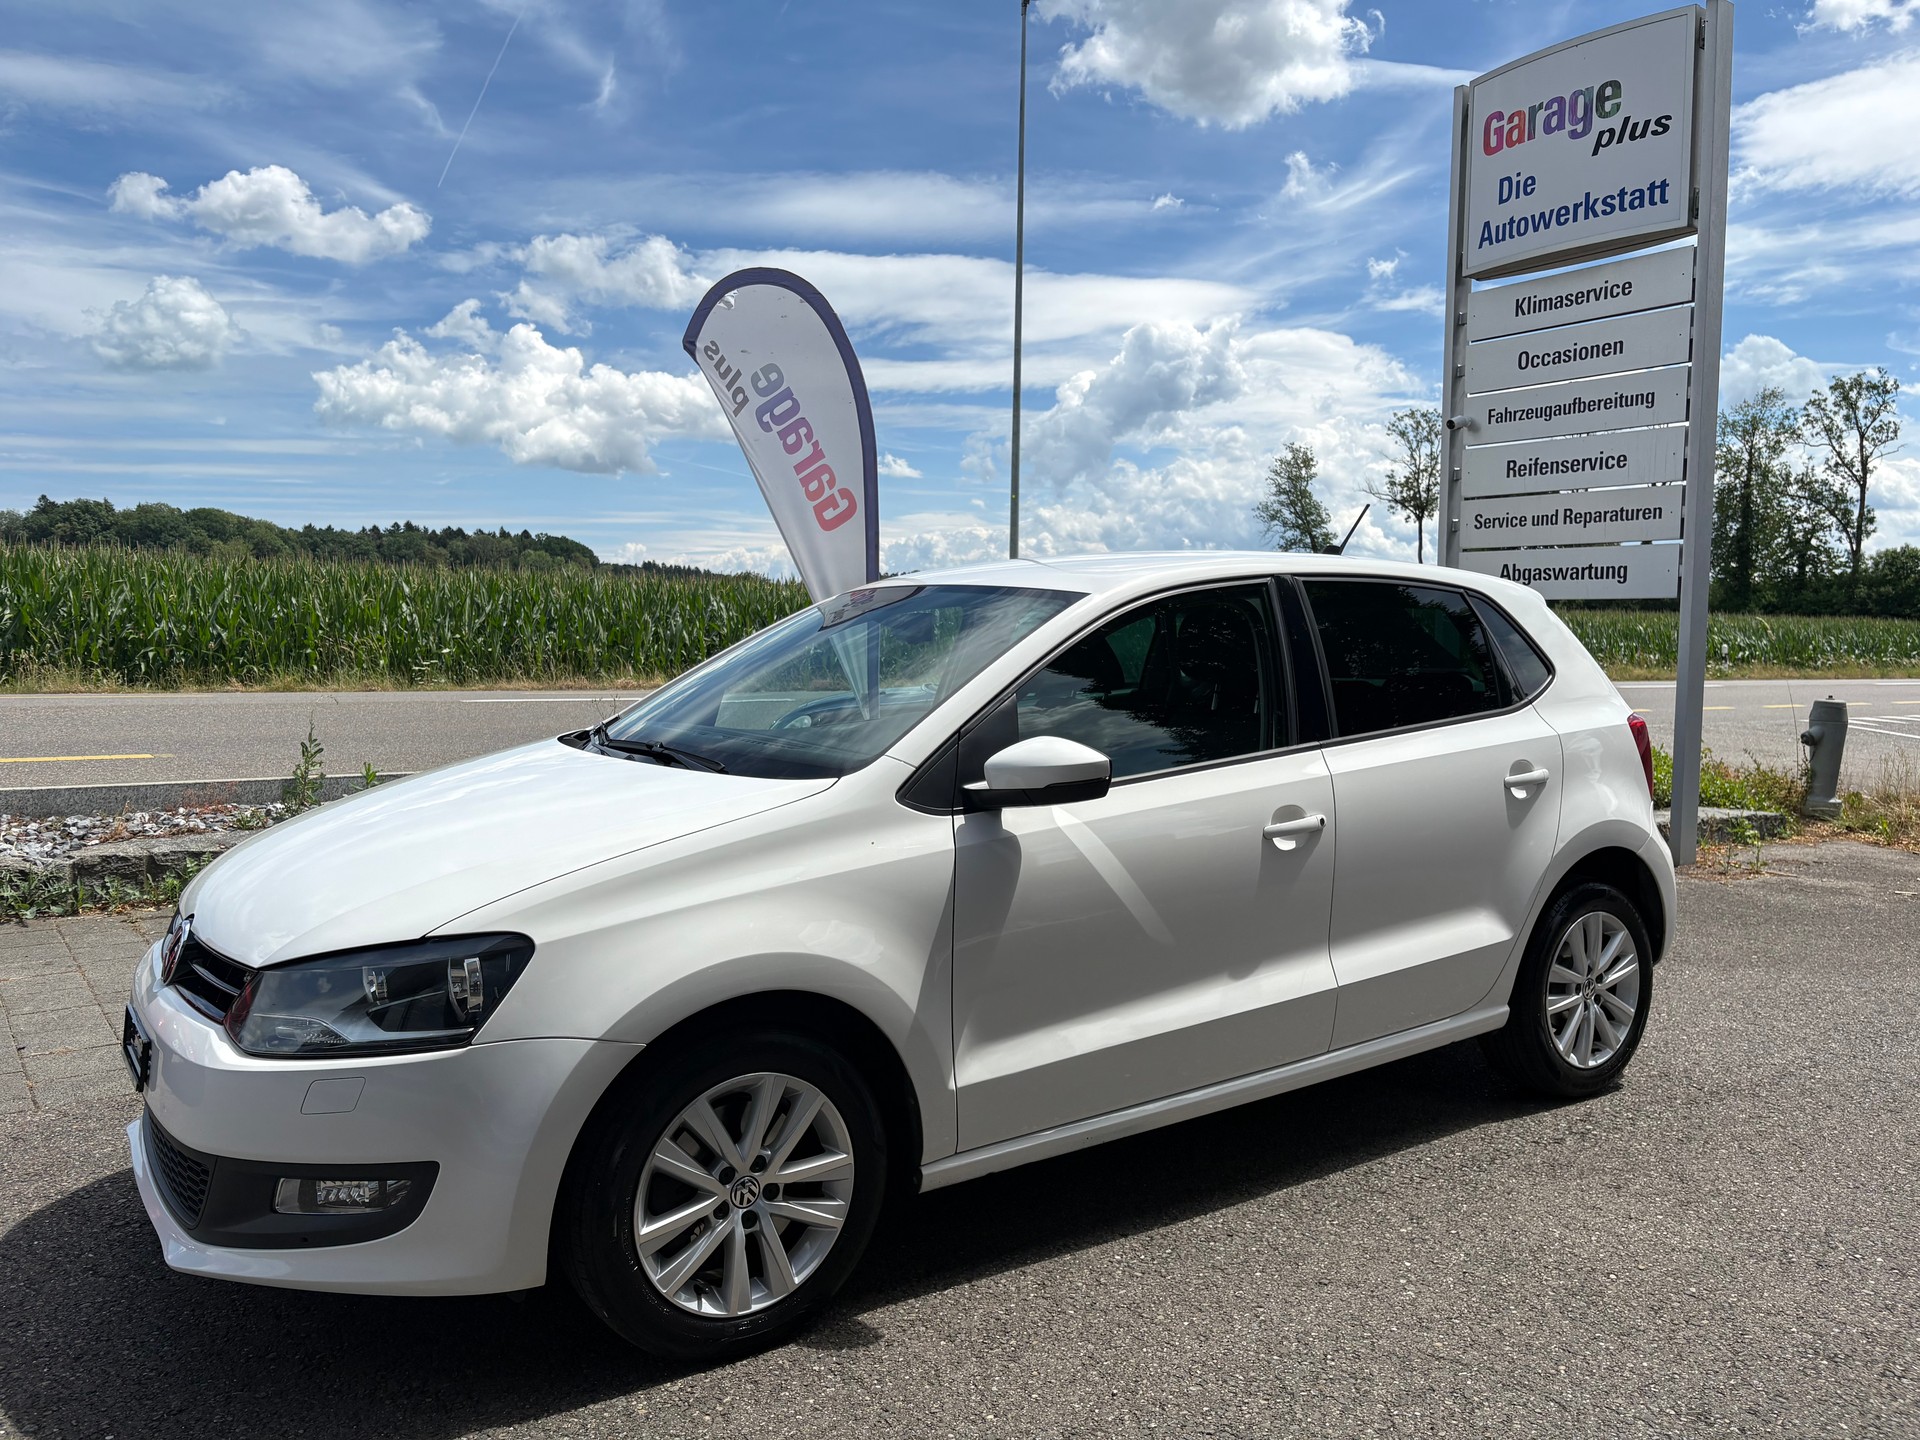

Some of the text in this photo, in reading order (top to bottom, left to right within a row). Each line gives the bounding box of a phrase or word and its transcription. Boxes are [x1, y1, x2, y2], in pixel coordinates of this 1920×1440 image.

[1482, 79, 1623, 156] Garage
[1591, 114, 1673, 156] plus
[1497, 172, 1537, 205] Die
[1478, 178, 1670, 250] Autowerkstatt
[1514, 279, 1633, 317] Klimaservice
[1517, 339, 1625, 371] Occasionen
[1487, 390, 1656, 425] Fahrzeugaufbereitung
[1506, 451, 1628, 479] Reifenservice
[1474, 505, 1663, 530] Service und Reparaturen
[1500, 562, 1628, 586] Abgaswartung
